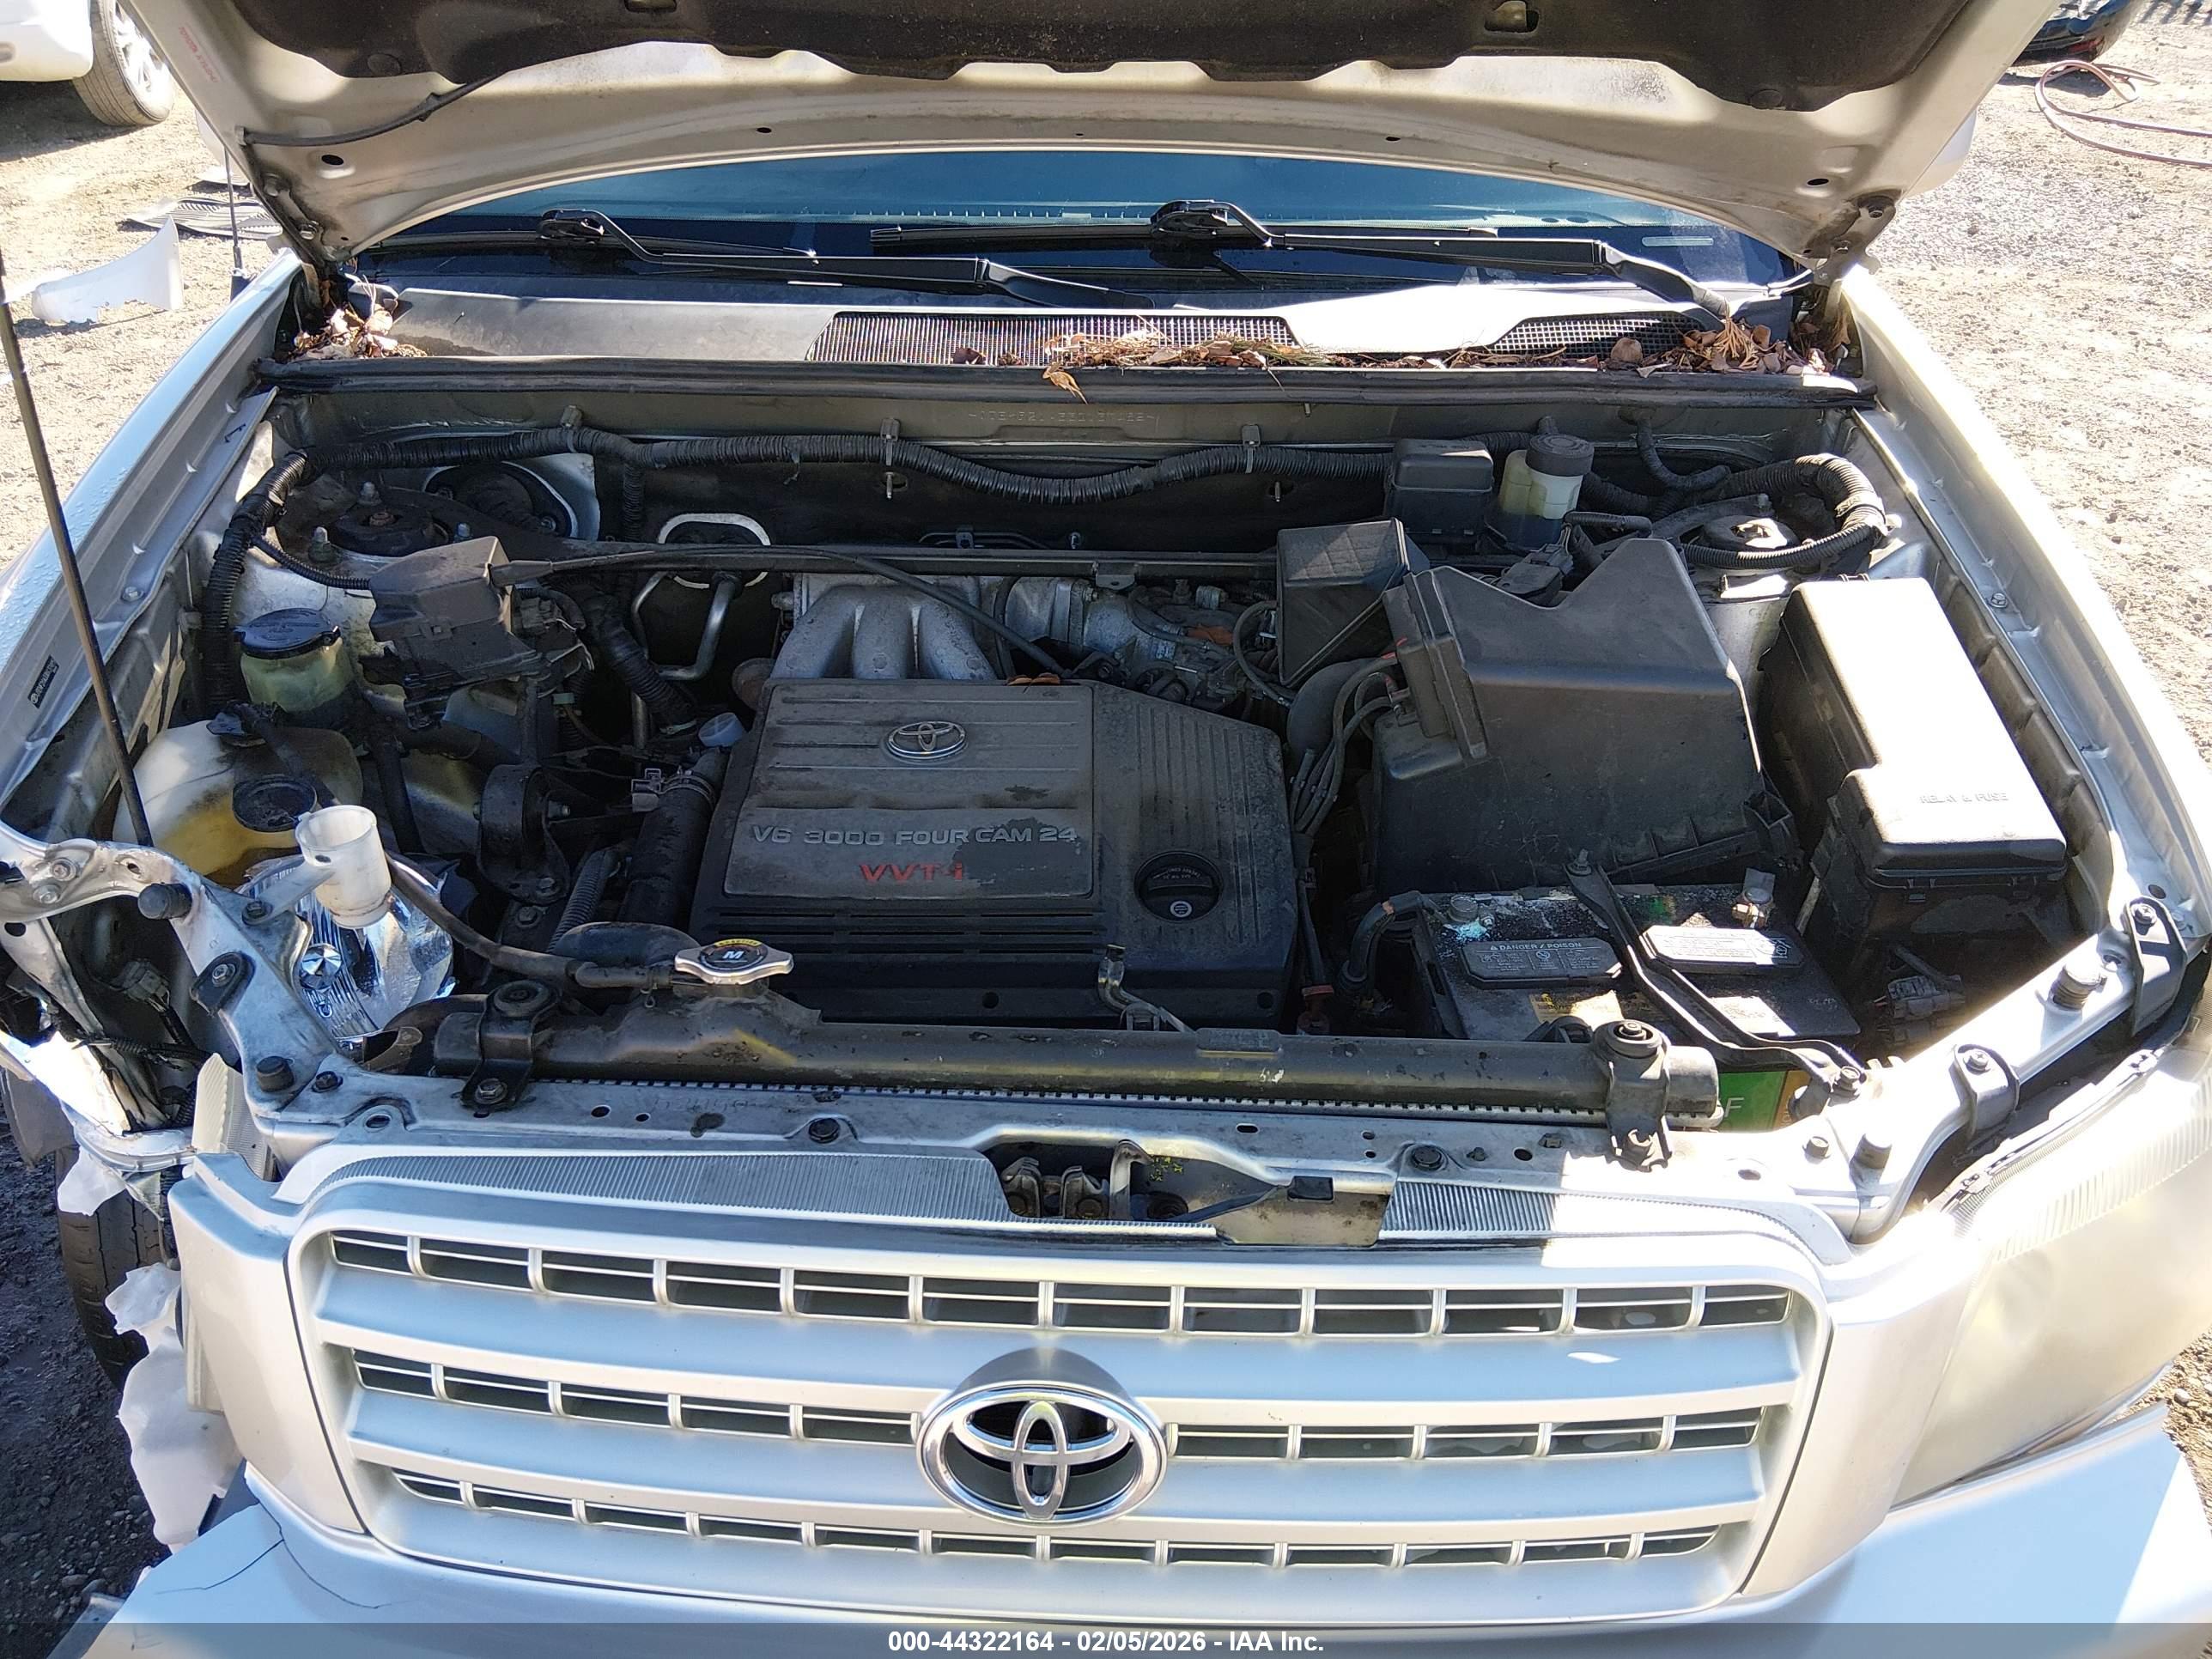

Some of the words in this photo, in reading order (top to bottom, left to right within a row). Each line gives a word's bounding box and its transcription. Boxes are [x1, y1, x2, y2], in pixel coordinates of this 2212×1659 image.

[1918, 793, 1958, 804] RELAY
[1961, 793, 1972, 802] &
[1975, 792, 2009, 802] FUSE
[751, 824, 793, 843] V6
[804, 830, 885, 846] 3000
[894, 828, 969, 846] FOUR
[975, 827, 1031, 843] CAM
[1039, 826, 1078, 842] 24
[1547, 941, 1583, 950] POISON
